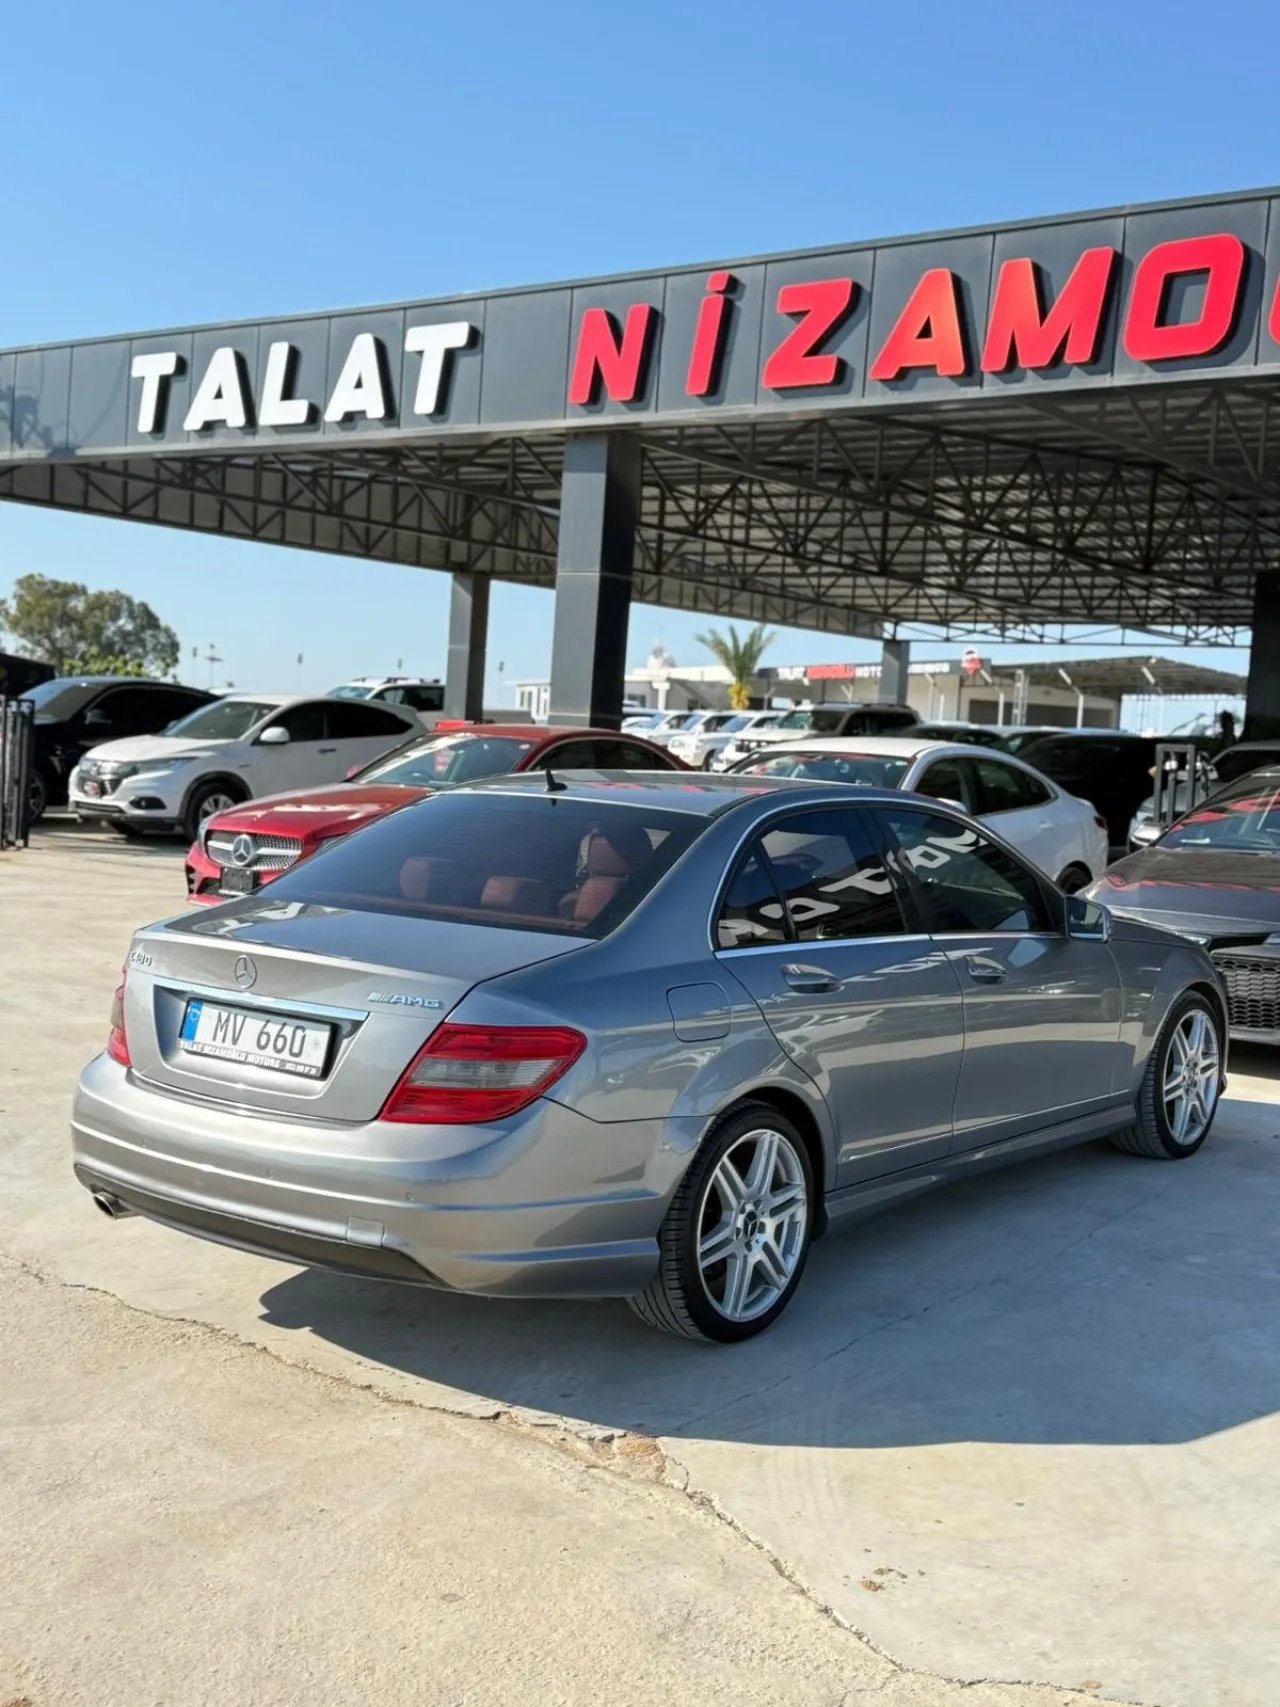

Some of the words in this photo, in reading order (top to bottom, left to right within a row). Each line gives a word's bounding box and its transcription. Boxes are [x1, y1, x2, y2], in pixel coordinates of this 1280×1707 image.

[131, 321, 472, 434] TALAT
[570, 233, 1280, 404] NİZAMO
[390, 994, 440, 1008] AMG
[212, 1011, 247, 1045] MV
[256, 1019, 307, 1058] 660
